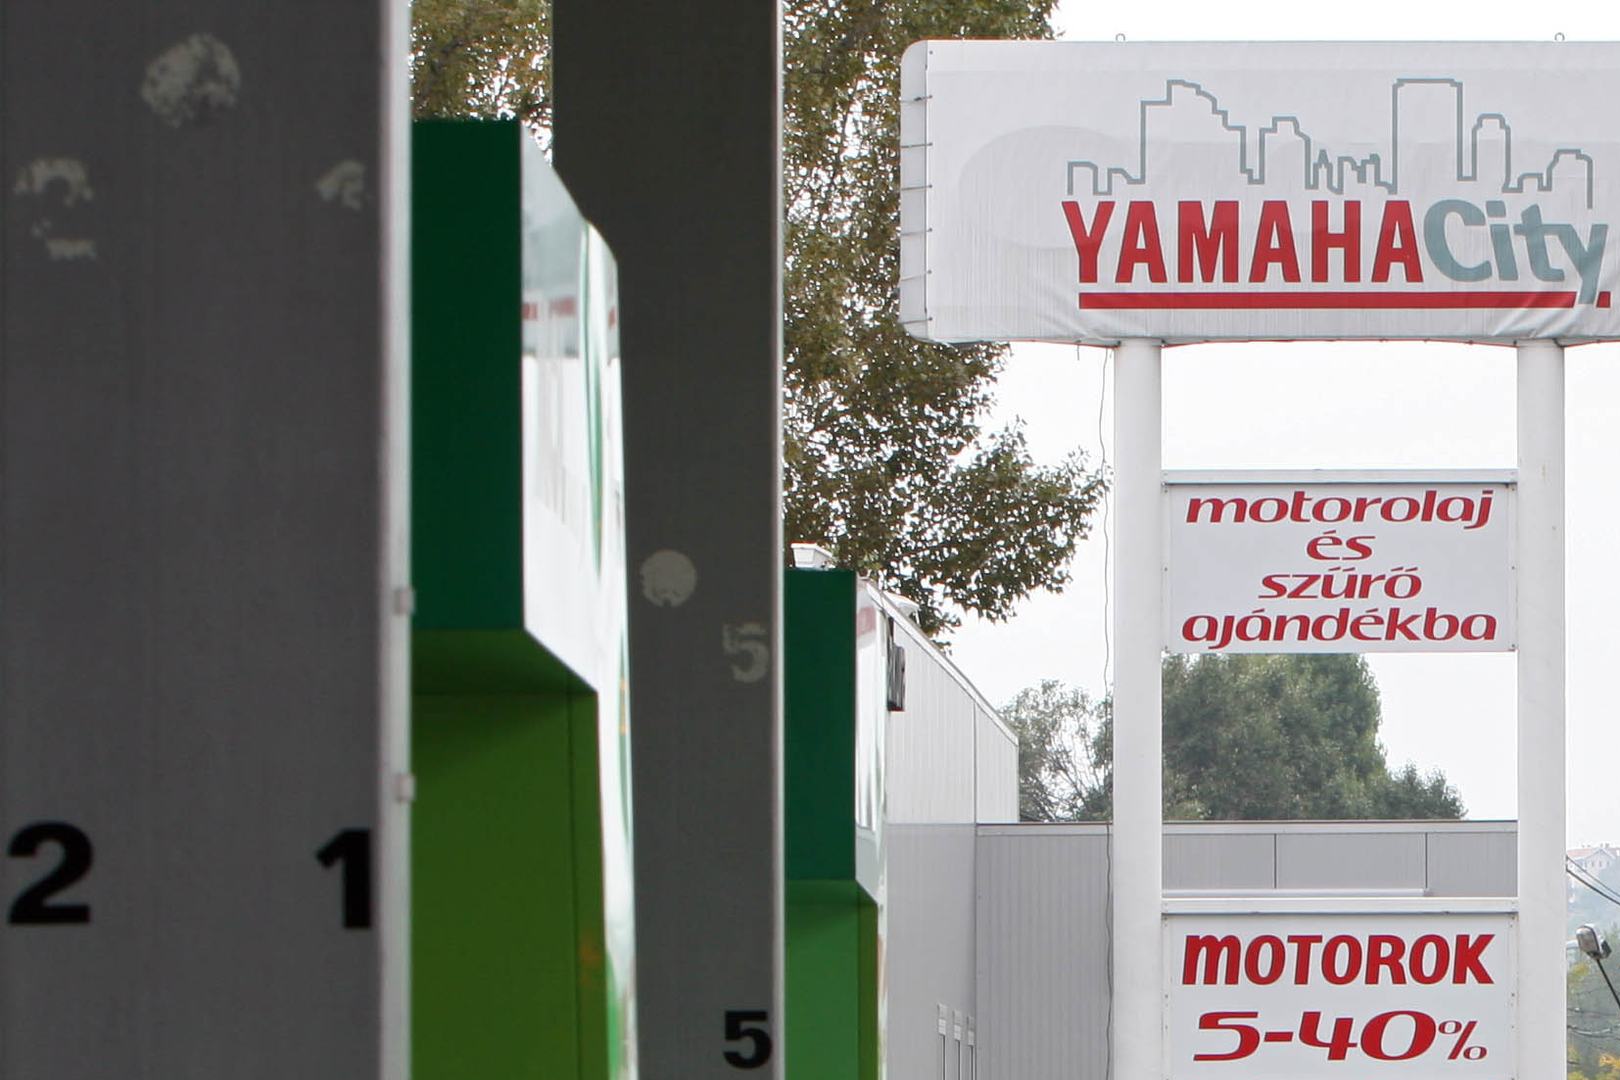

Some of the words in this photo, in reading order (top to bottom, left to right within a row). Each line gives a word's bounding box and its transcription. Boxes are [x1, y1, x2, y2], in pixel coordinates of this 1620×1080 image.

[1186, 490, 1493, 529] motorolaj
[1307, 528, 1373, 560] és
[1258, 566, 1422, 600] szűrő
[1181, 606, 1498, 650] ajándékba
[6, 821, 94, 926] 2
[315, 828, 372, 930] 1
[1182, 934, 1495, 986] MOTOROK
[723, 1010, 772, 1069] 5
[1193, 1010, 1488, 1062] 5-40%
